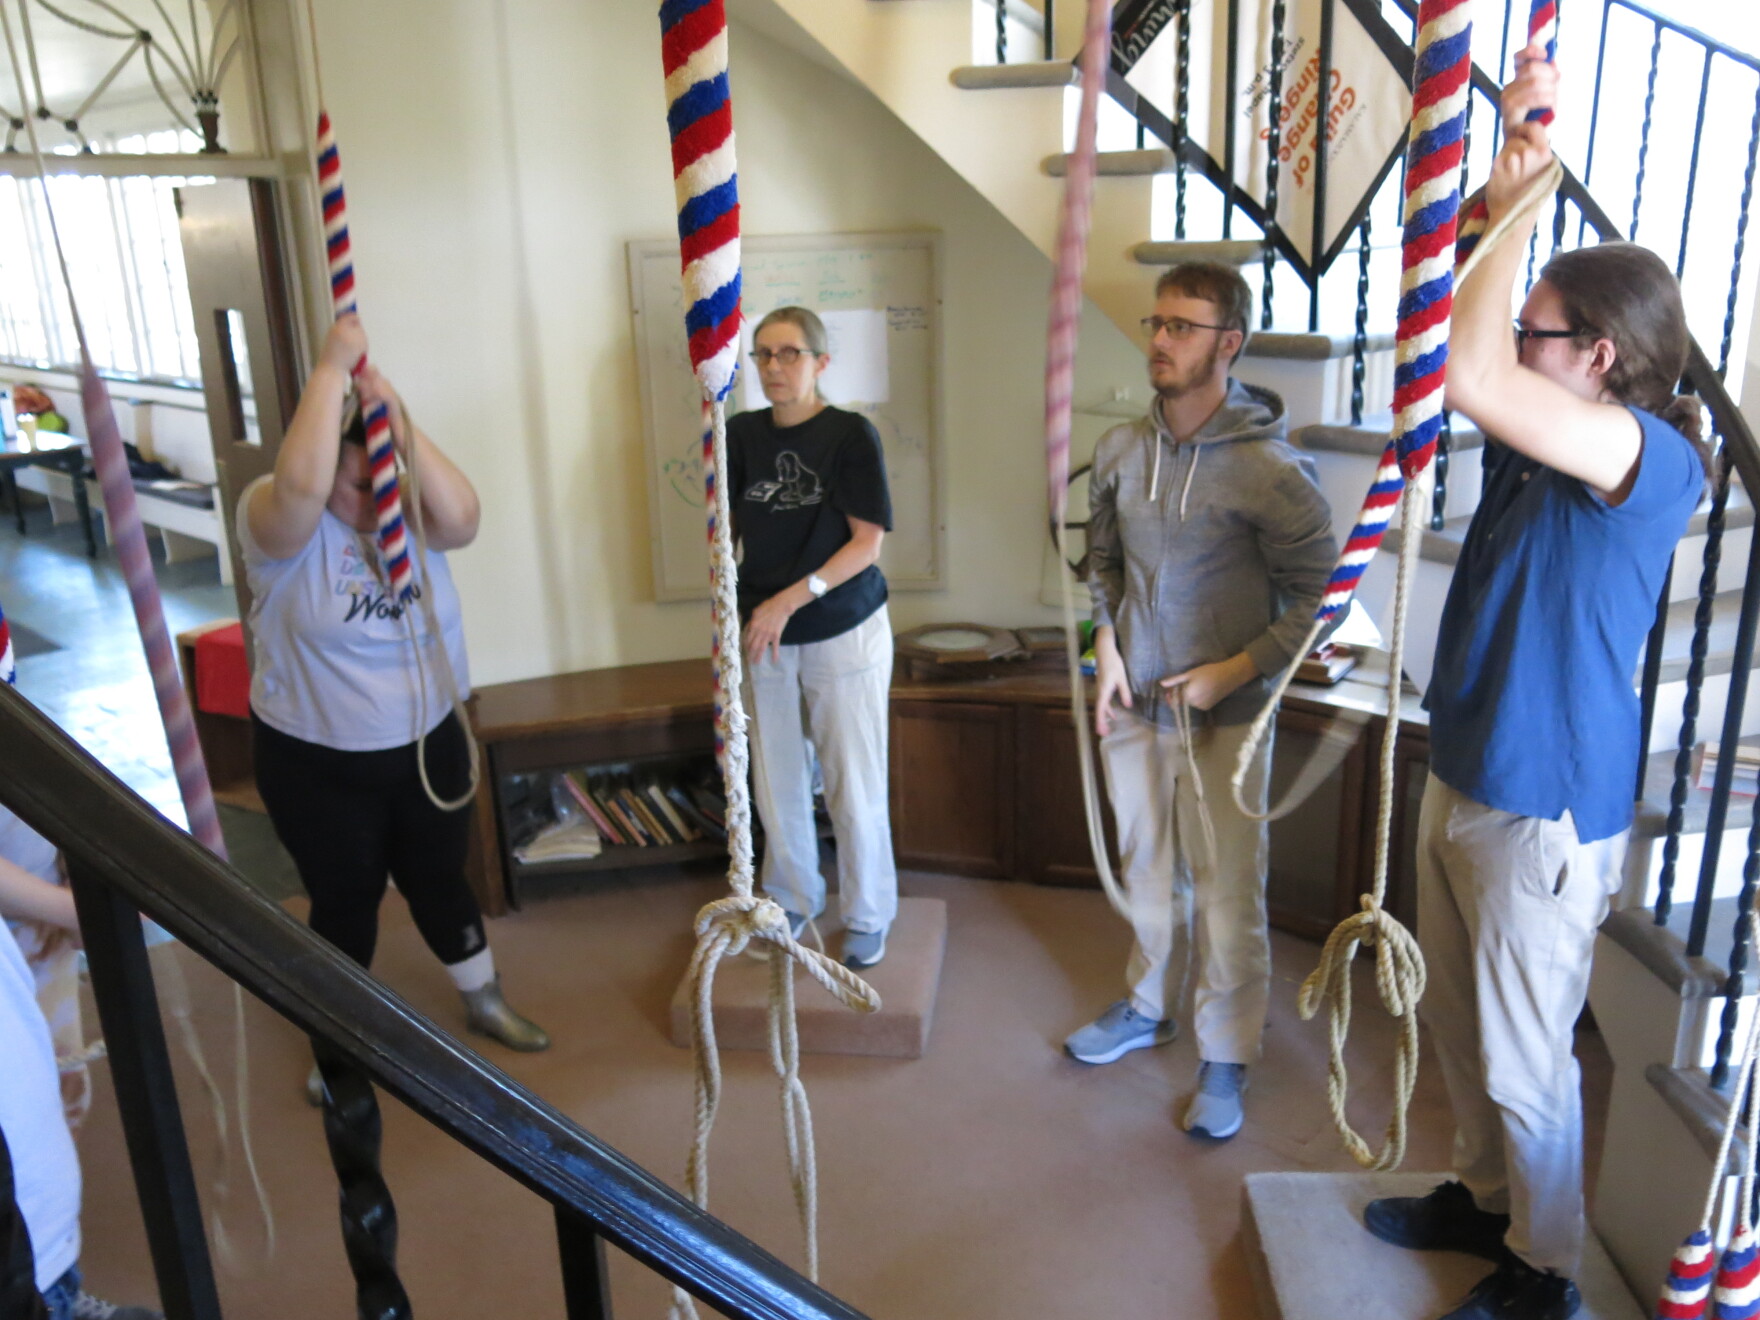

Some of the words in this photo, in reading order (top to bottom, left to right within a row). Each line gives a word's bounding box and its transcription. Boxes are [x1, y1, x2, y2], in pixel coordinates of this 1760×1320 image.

[1258, 46, 1322, 141] Ringe
[1277, 68, 1342, 162] Cange
[1292, 154, 1311, 189] of
